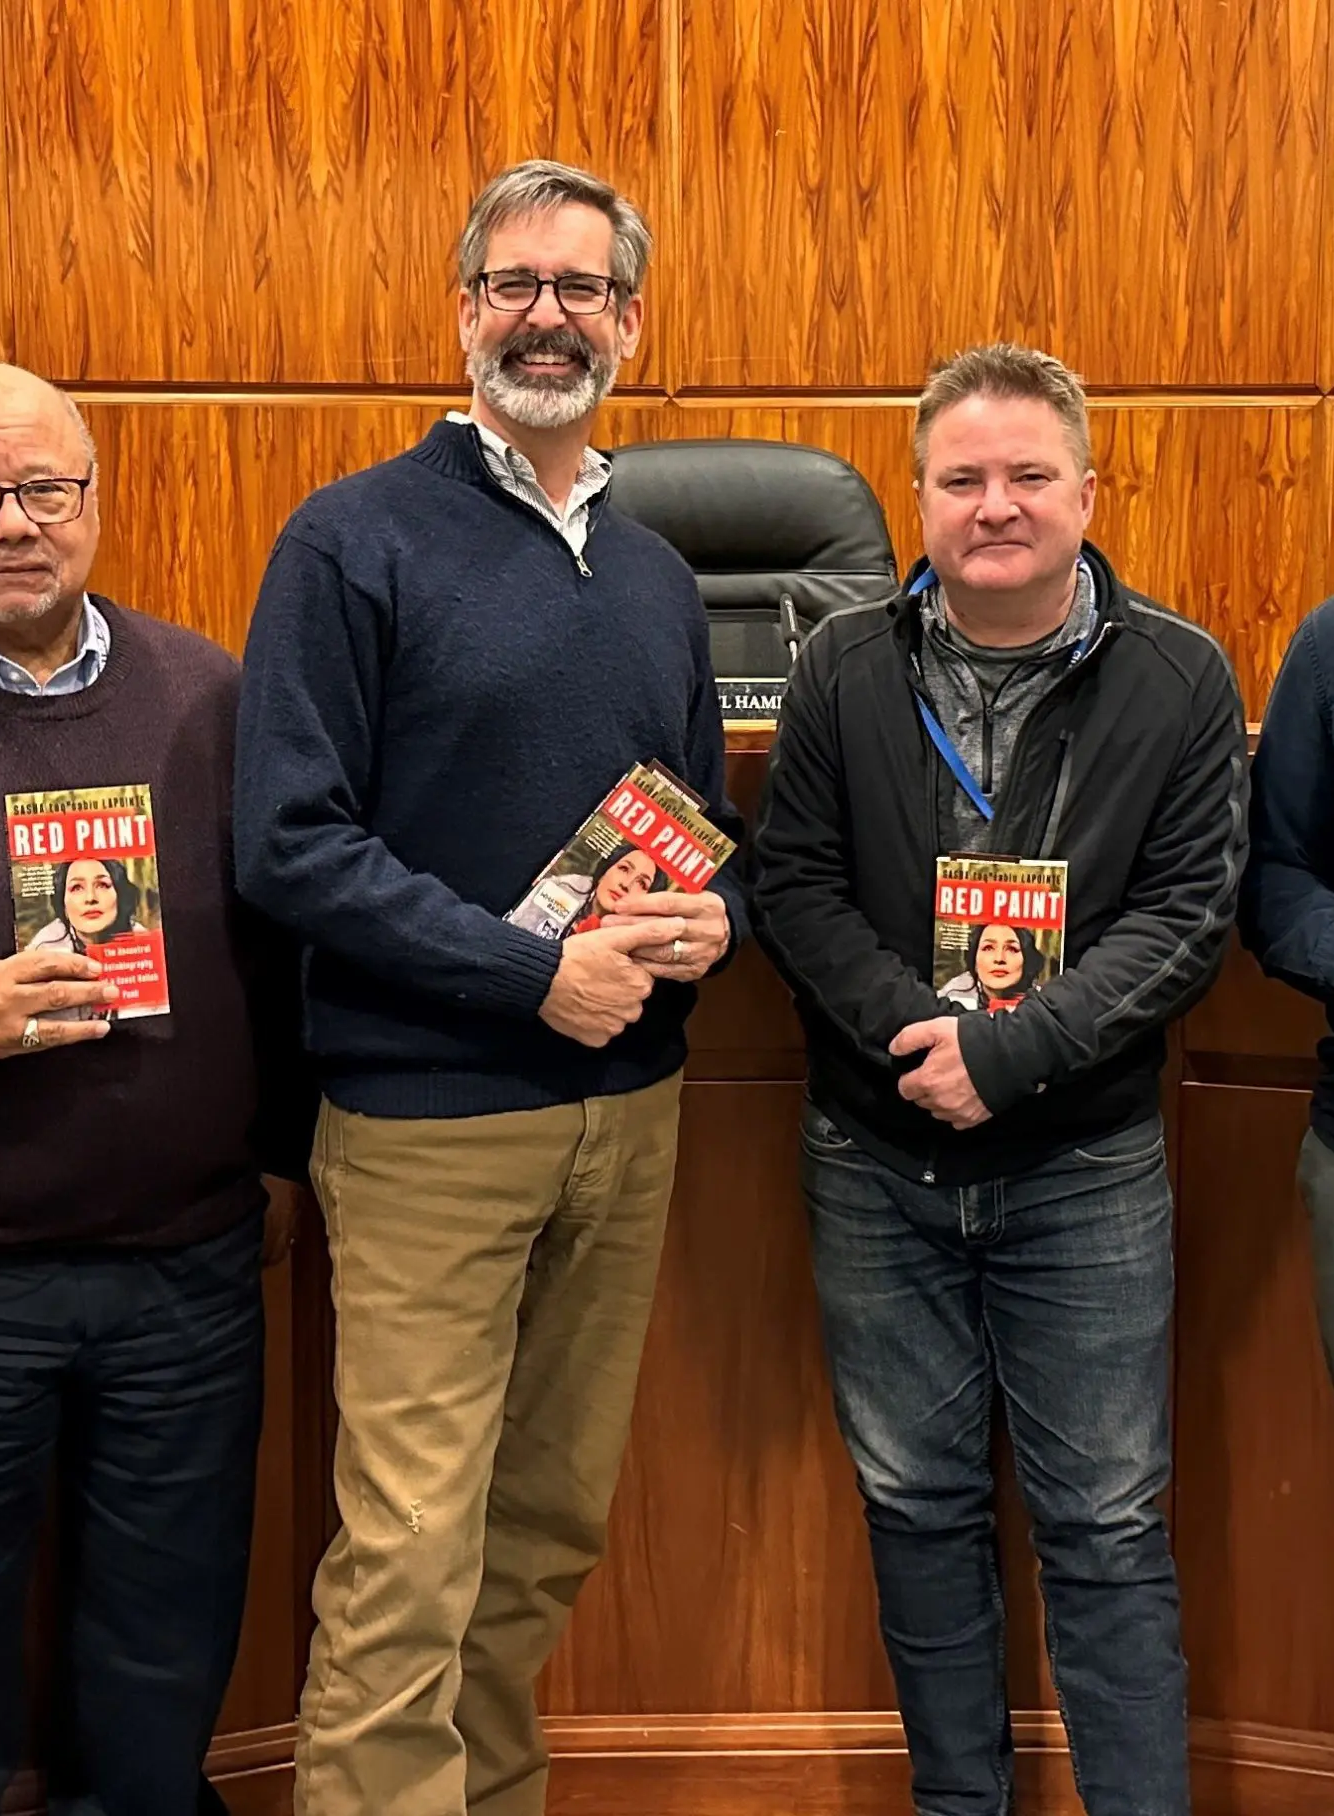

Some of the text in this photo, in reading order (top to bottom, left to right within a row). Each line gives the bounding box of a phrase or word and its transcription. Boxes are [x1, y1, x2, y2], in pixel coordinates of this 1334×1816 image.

[14, 815, 146, 856] RED PAINT
[608, 789, 658, 836] RED
[649, 825, 716, 884] PAINT
[940, 887, 1060, 920] RED PAINT
